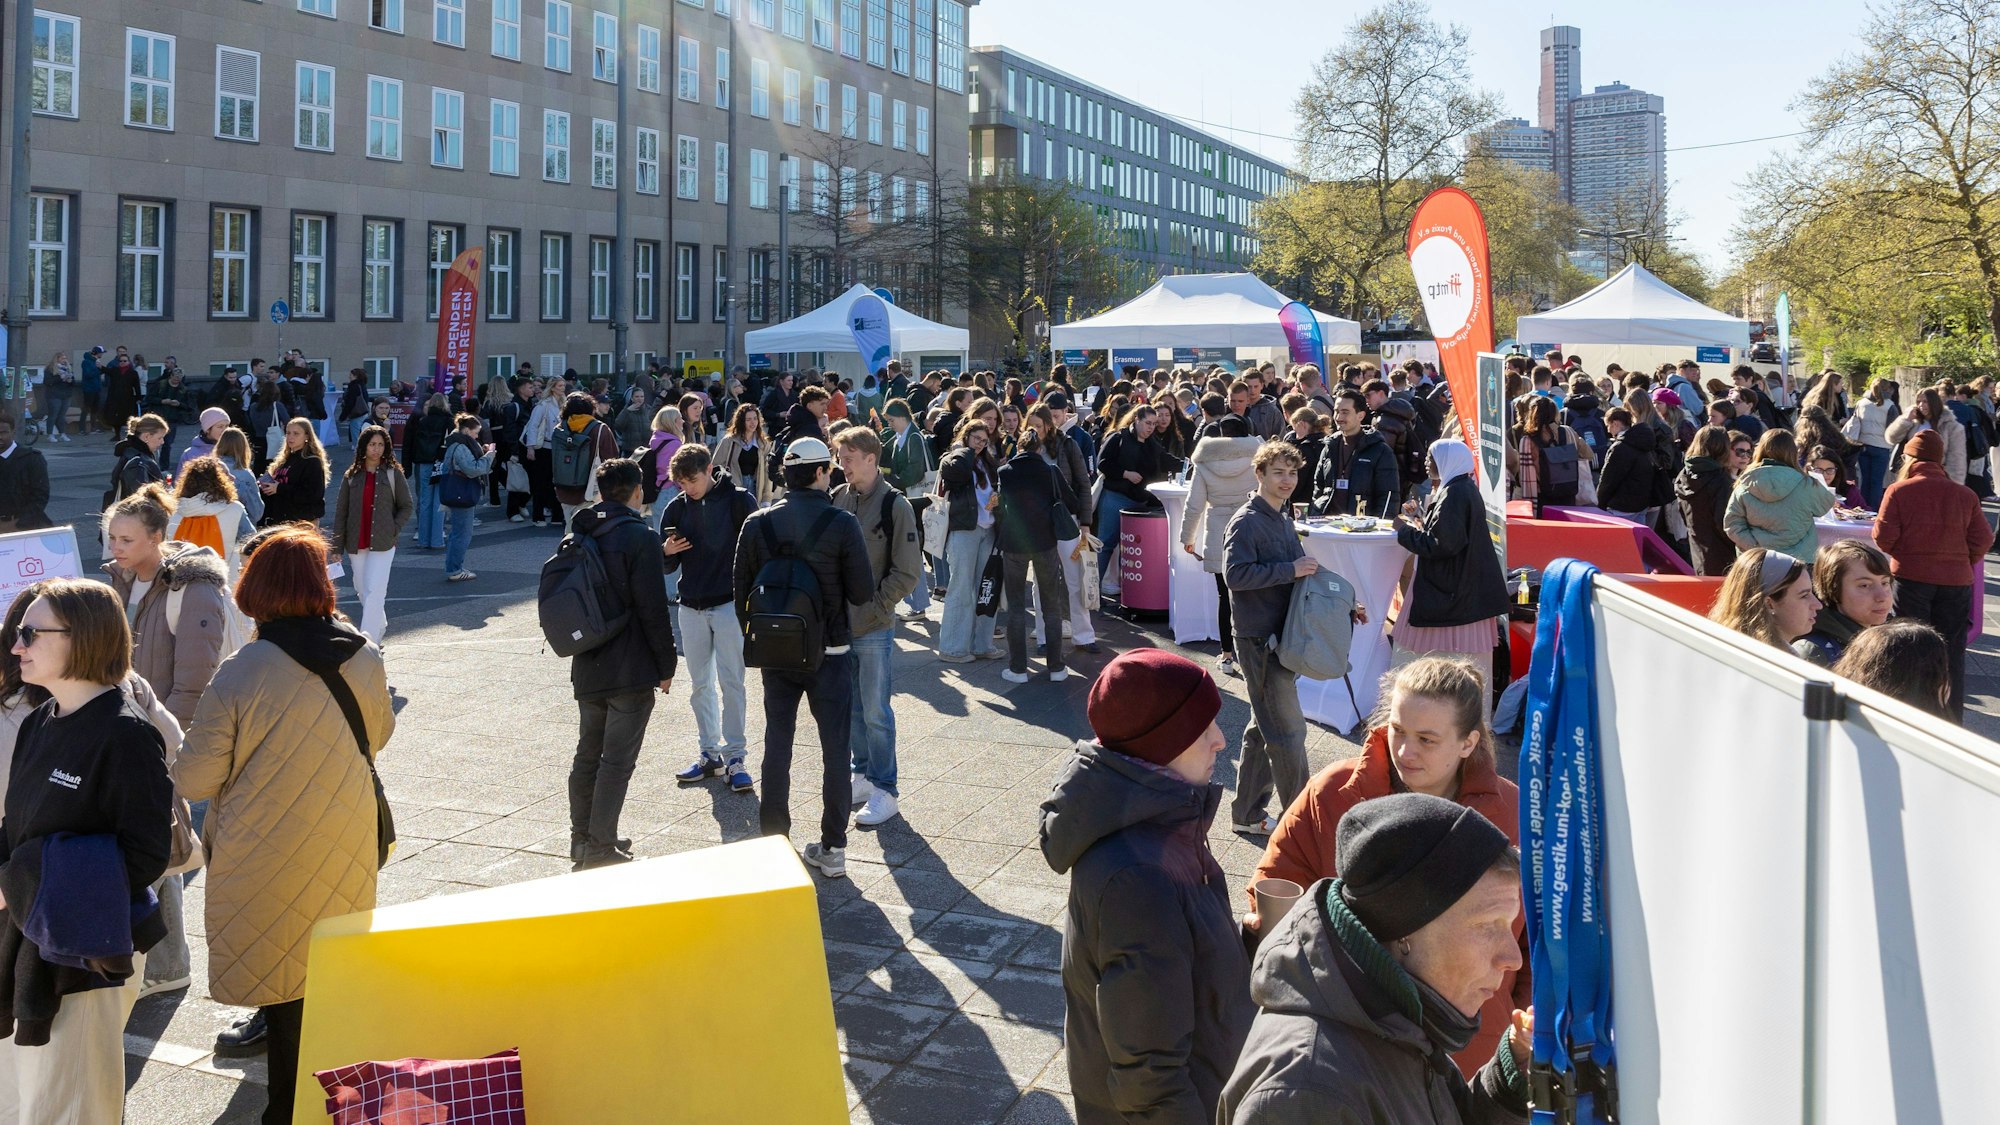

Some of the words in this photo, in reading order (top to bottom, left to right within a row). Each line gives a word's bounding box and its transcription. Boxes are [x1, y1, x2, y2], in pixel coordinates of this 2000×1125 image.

[448, 287, 463, 359] SPENDEN.
[459, 292, 472, 348] RETTEN
[1529, 777, 1543, 836] Gender
[1572, 726, 1593, 924] www.gestik.uni-koeln.de
